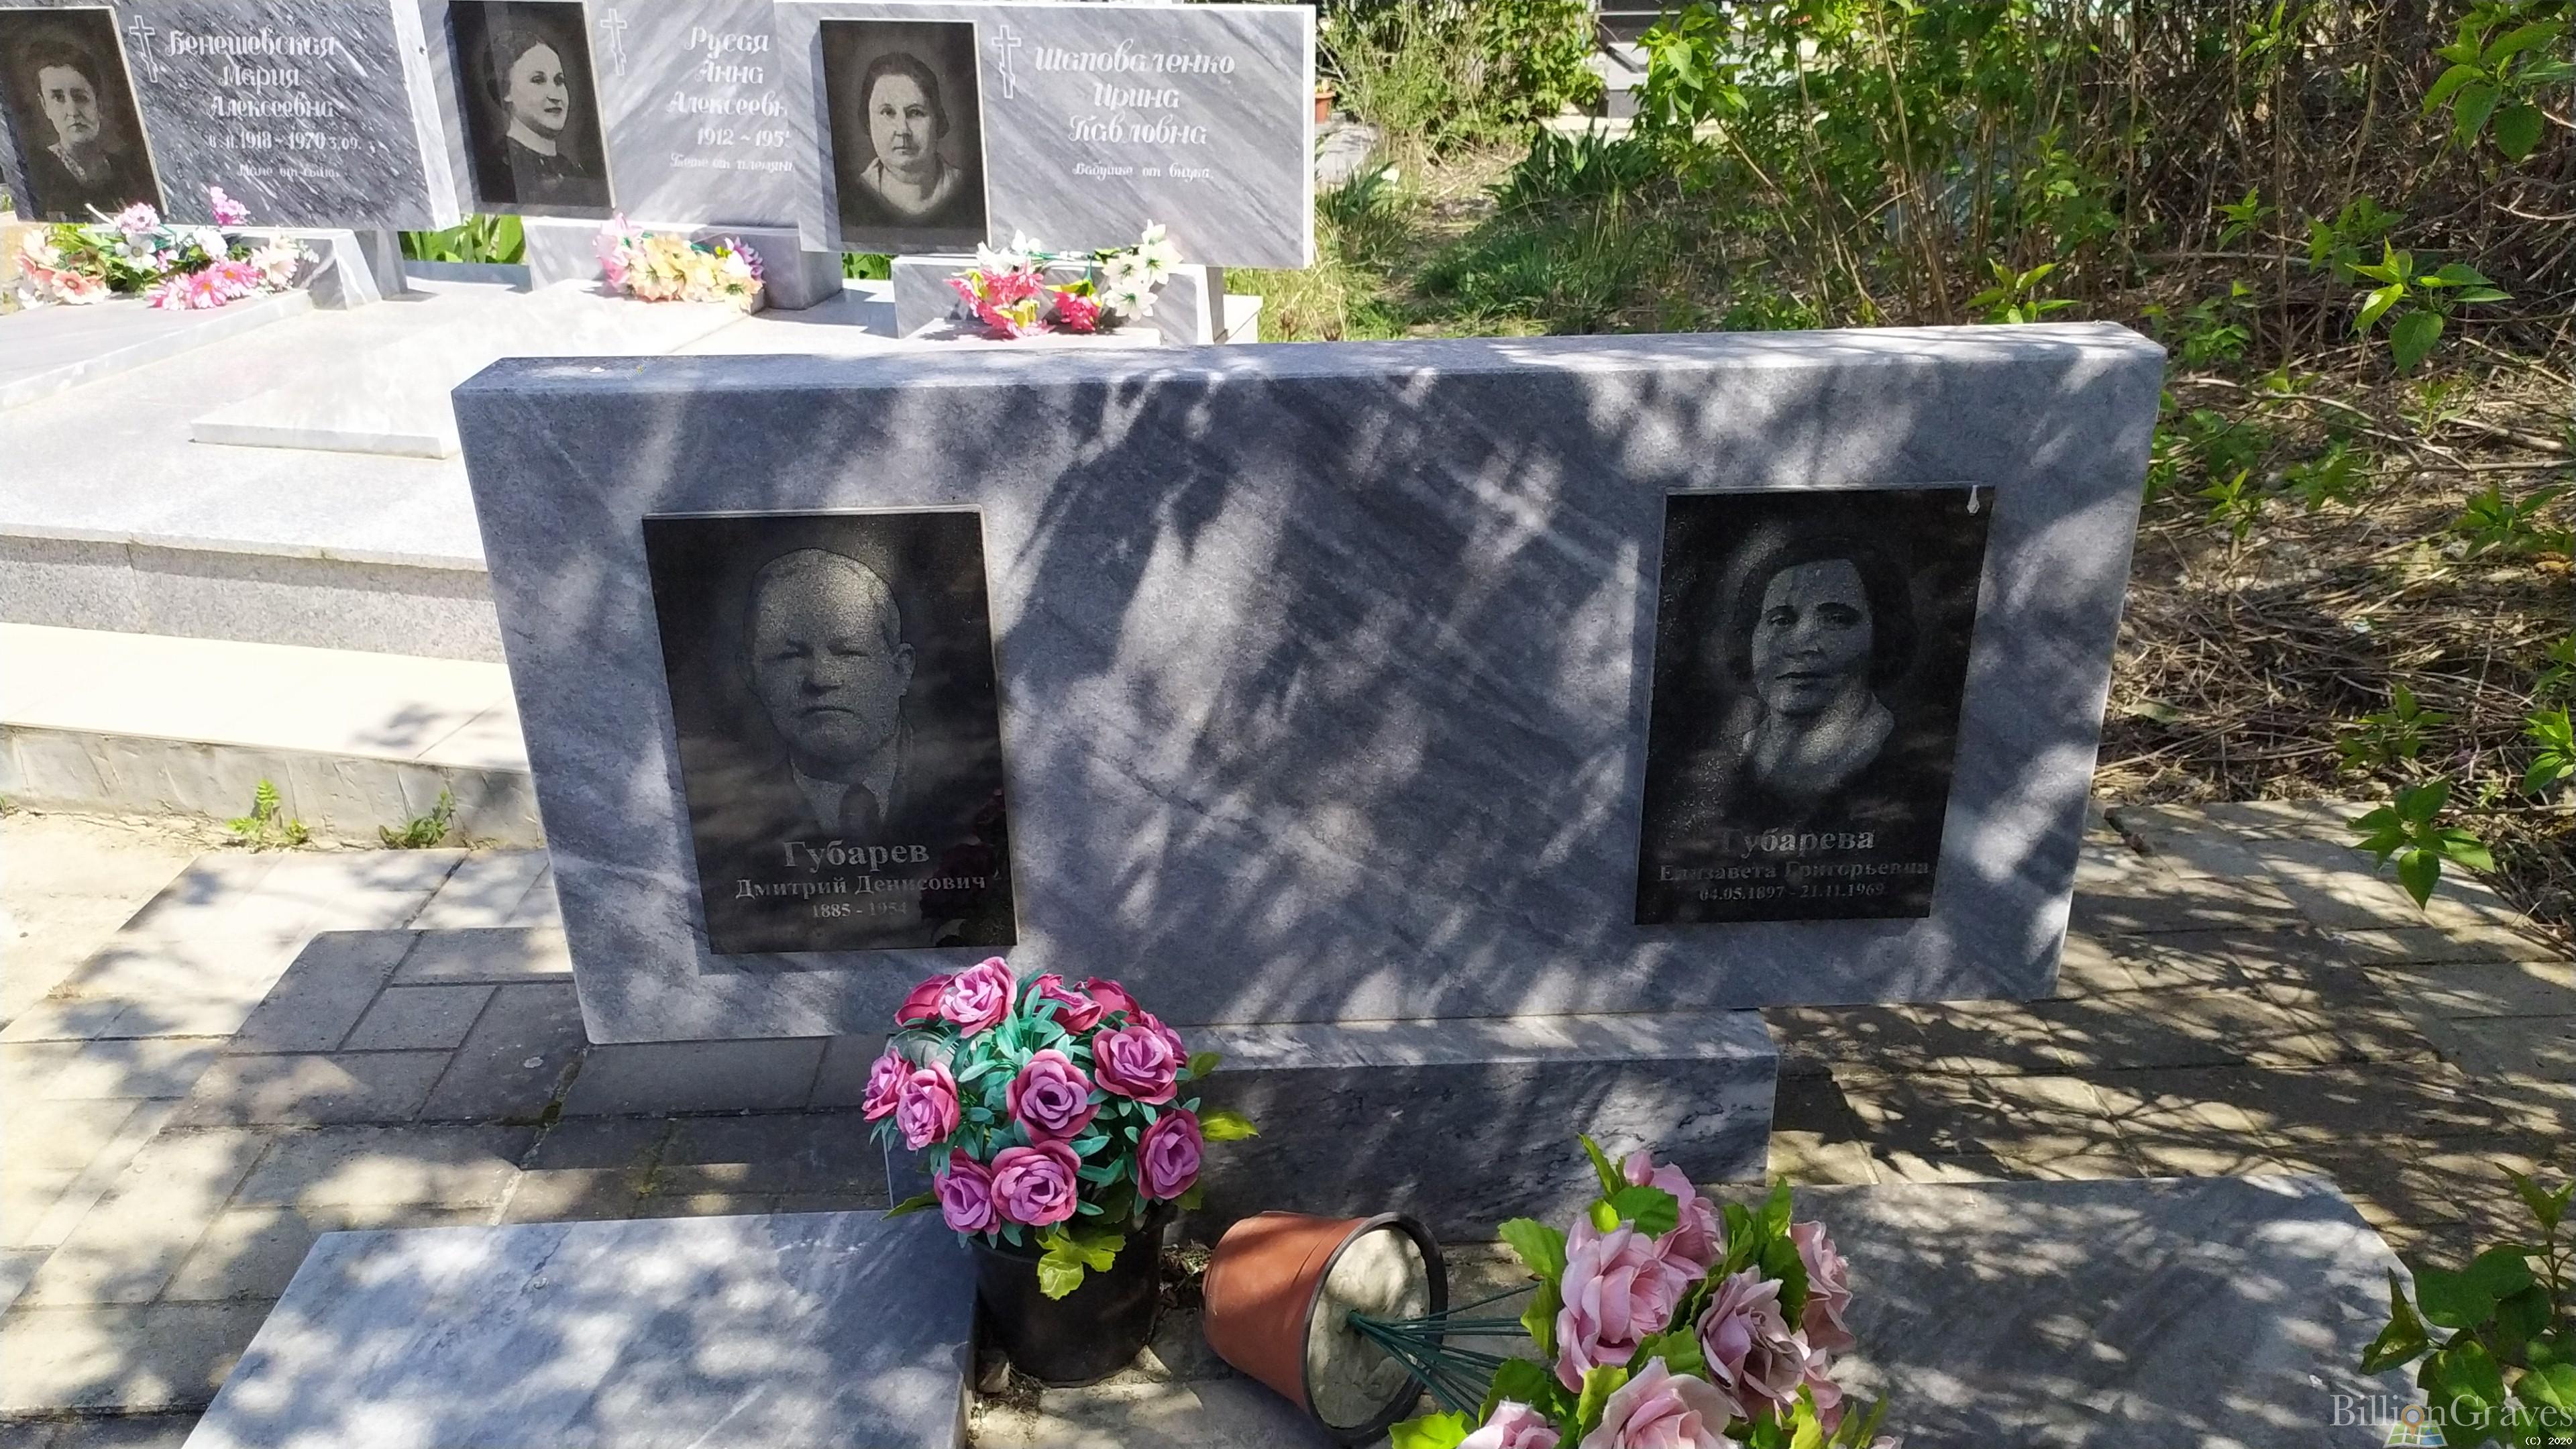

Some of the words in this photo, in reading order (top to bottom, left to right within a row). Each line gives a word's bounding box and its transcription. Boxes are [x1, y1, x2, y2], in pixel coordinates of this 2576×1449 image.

[165, 24, 337, 58] Бенешевская
[684, 26, 769, 59] Русая
[1035, 38, 1235, 74] Шаповаленко
[219, 66, 301, 95] Мария
[694, 60, 763, 85] Анна
[206, 91, 333, 118] Алексеевна
[1094, 82, 1180, 110] Ирина
[697, 127, 734, 146] 1912
[1068, 110, 1208, 145] Павловна
[1072, 160, 1133, 181] Бабушке
[1142, 166, 1161, 178] от
[783, 839, 930, 873] Губарев
[1723, 827, 1876, 859] Губарева
[1659, 864, 1776, 882] Елизавета
[1785, 861, 1929, 880] Григорьевна
[735, 876, 847, 901] Дмитрий
[854, 874, 987, 896] Денисович
[1699, 885, 1785, 901] 04.05.1897
[812, 902, 851, 918] 1885
[868, 901, 908, 916] 1954
